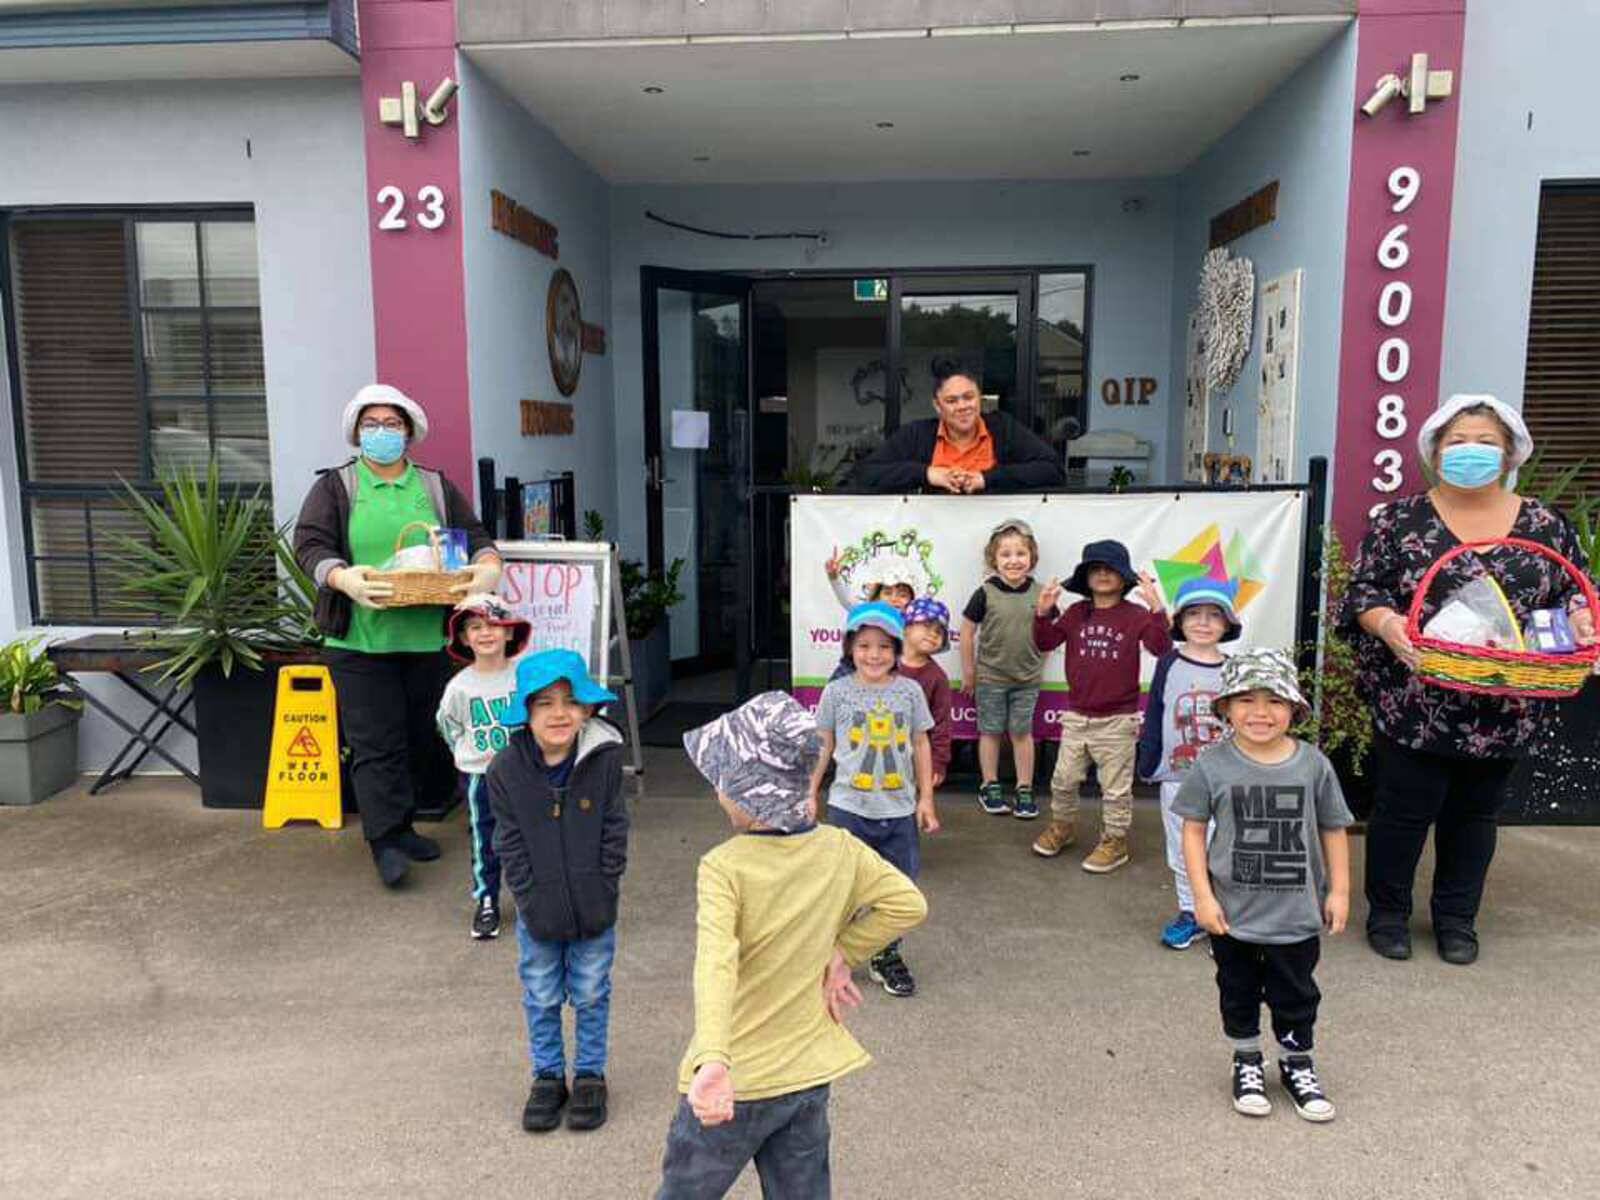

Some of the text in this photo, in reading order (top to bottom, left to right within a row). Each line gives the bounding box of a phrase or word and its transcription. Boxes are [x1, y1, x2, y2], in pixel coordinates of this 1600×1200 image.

[376, 185, 446, 230] 23
[1369, 166, 1421, 519] 960083
[1102, 377, 1158, 406] QIP
[502, 562, 582, 613] STOP
[810, 628, 841, 642] YOU
[283, 713, 327, 722] CAUTION
[287, 761, 321, 770] WET
[278, 772, 329, 782] FLOOR
